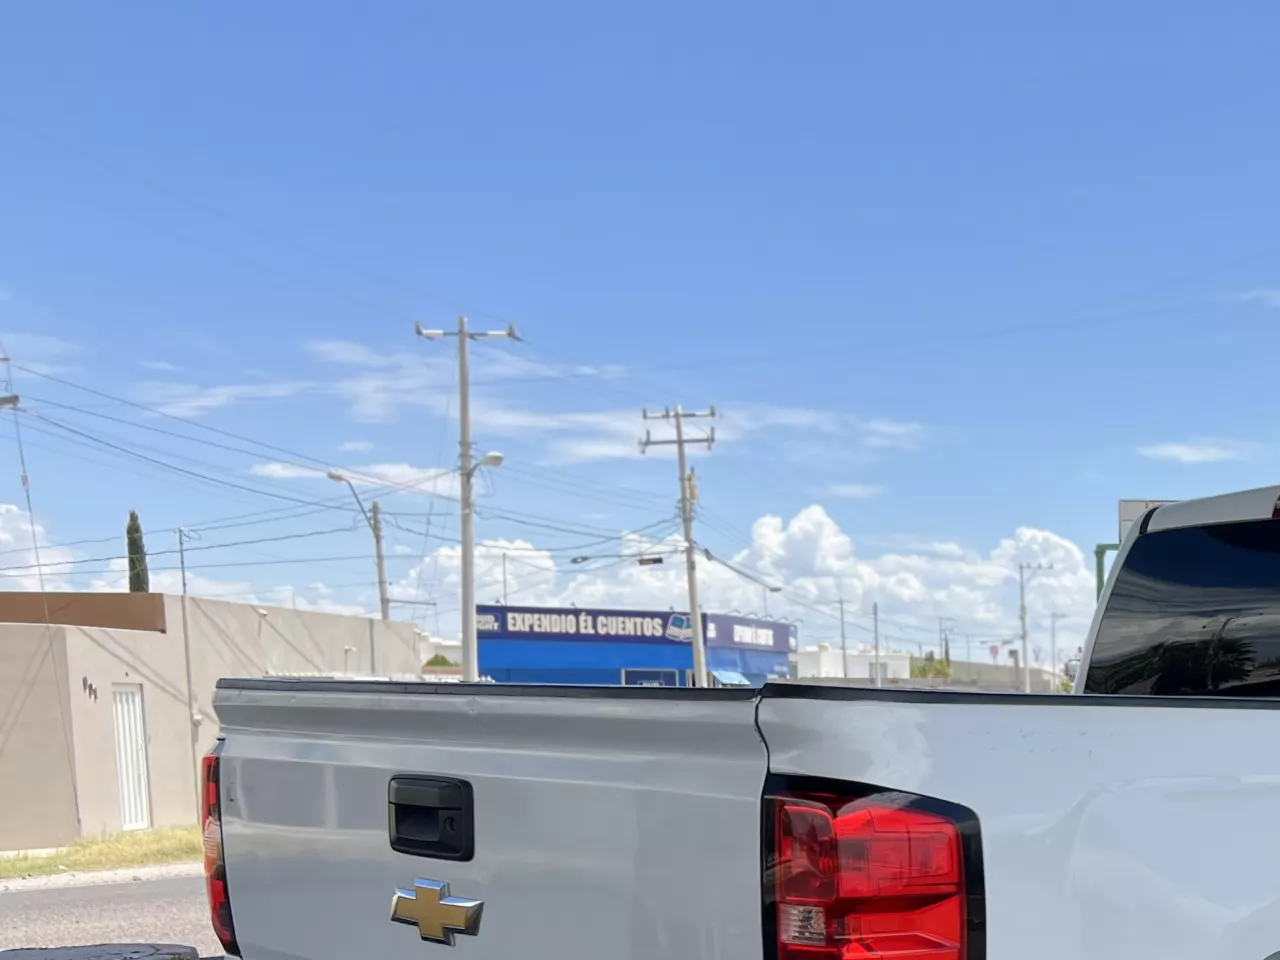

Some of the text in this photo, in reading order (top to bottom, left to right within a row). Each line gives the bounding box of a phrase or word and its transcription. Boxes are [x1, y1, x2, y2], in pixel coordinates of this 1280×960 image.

[507, 612, 577, 634] EXPENDIO
[579, 612, 595, 634] ÉL
[597, 615, 663, 637] CUENTOS
